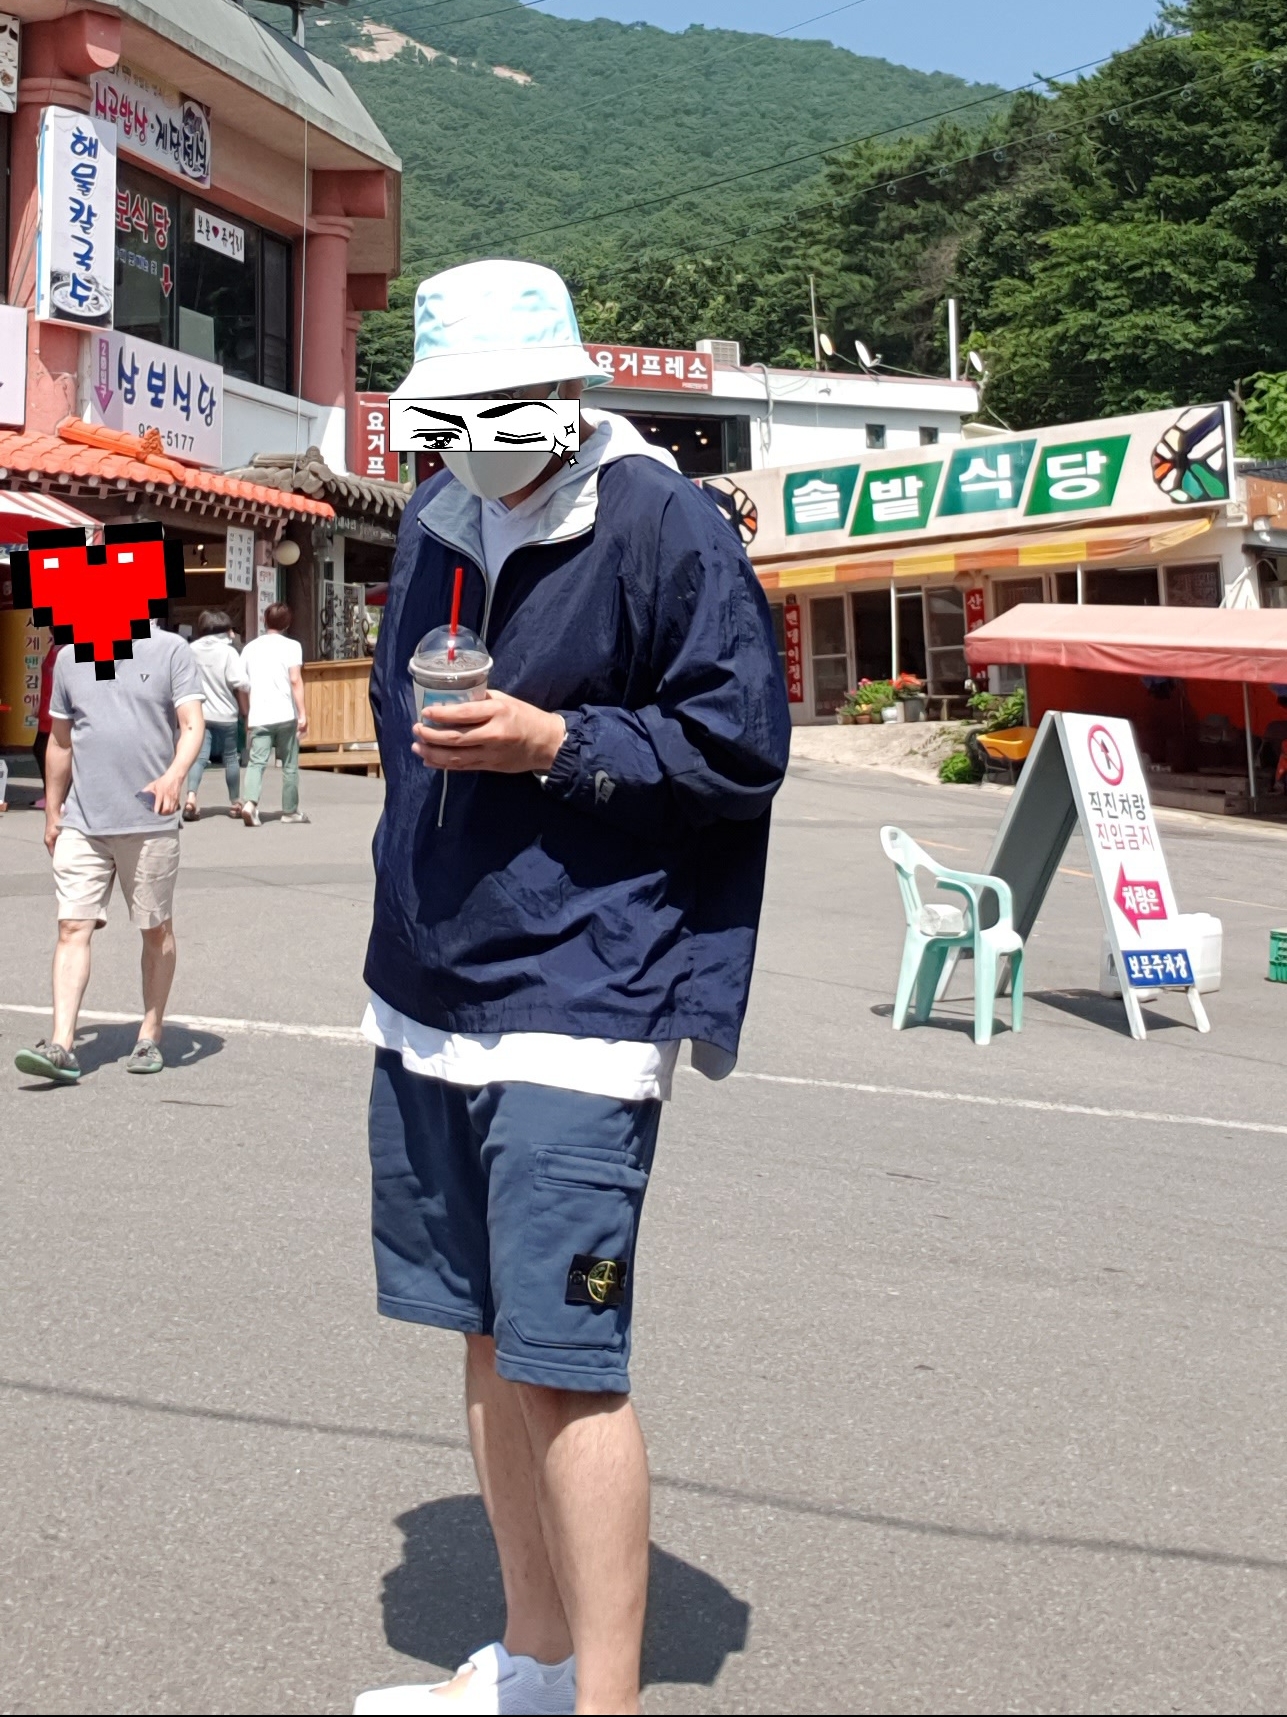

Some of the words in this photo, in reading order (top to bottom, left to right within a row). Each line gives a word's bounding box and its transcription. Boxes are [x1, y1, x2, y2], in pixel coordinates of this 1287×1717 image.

[69, 127, 99, 308] 해물칼국수
[595, 350, 709, 380] 요거프레소
[117, 345, 217, 428] 삼보식당
[791, 450, 1108, 524] 솔밭식당
[1088, 791, 1147, 821] 직진차량
[1096, 823, 1155, 852] 진입금지
[1121, 885, 1160, 915] 차량은
[1128, 953, 1188, 981] 보문주차장
